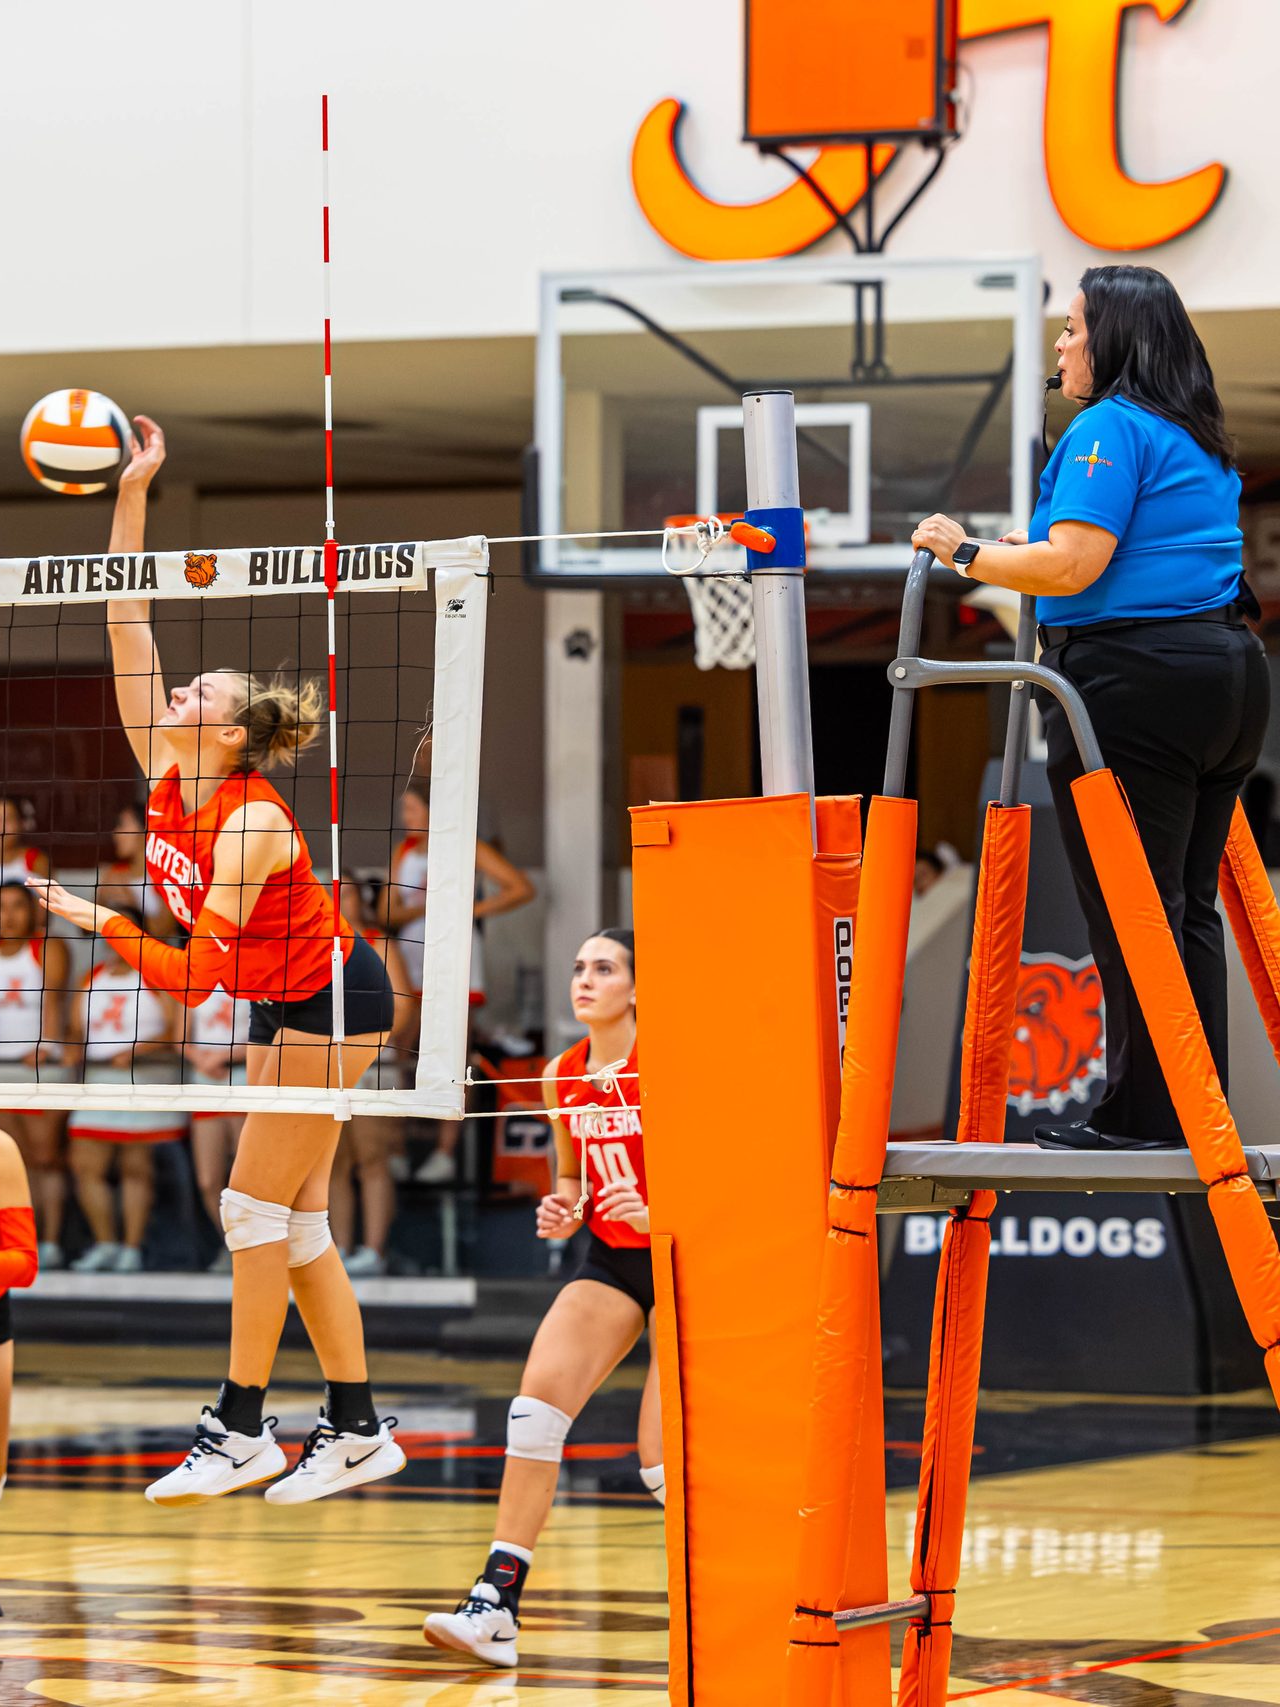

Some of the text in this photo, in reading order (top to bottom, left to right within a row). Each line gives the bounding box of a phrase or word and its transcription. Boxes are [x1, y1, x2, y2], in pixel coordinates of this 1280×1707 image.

[22, 555, 159, 595] ARTESIA
[146, 832, 205, 892] ARTESIA
[588, 1141, 639, 1187] 10
[904, 1215, 1167, 1259] BLDOGS
